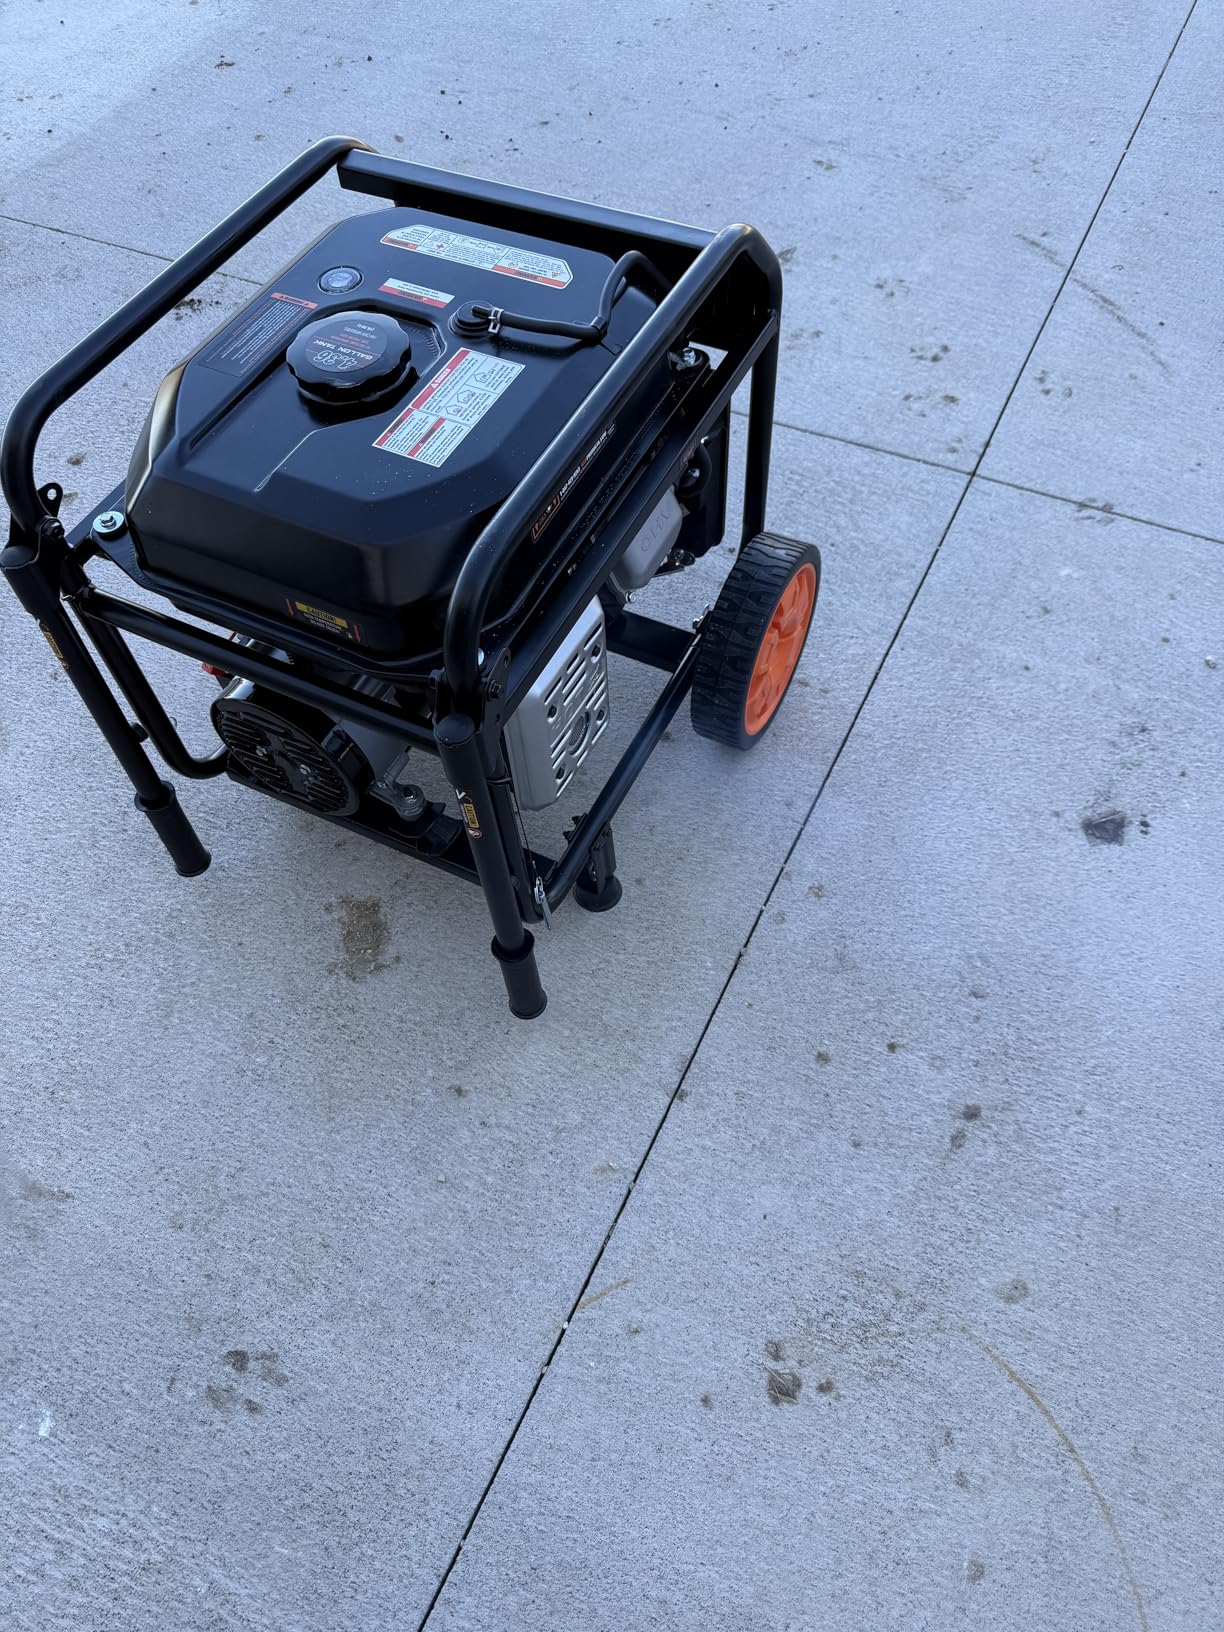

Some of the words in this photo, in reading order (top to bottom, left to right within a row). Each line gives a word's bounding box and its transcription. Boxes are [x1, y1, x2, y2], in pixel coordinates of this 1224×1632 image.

[313, 339, 336, 350] TANK
[314, 350, 358, 369] 4.36
[338, 346, 374, 360] GALLON
